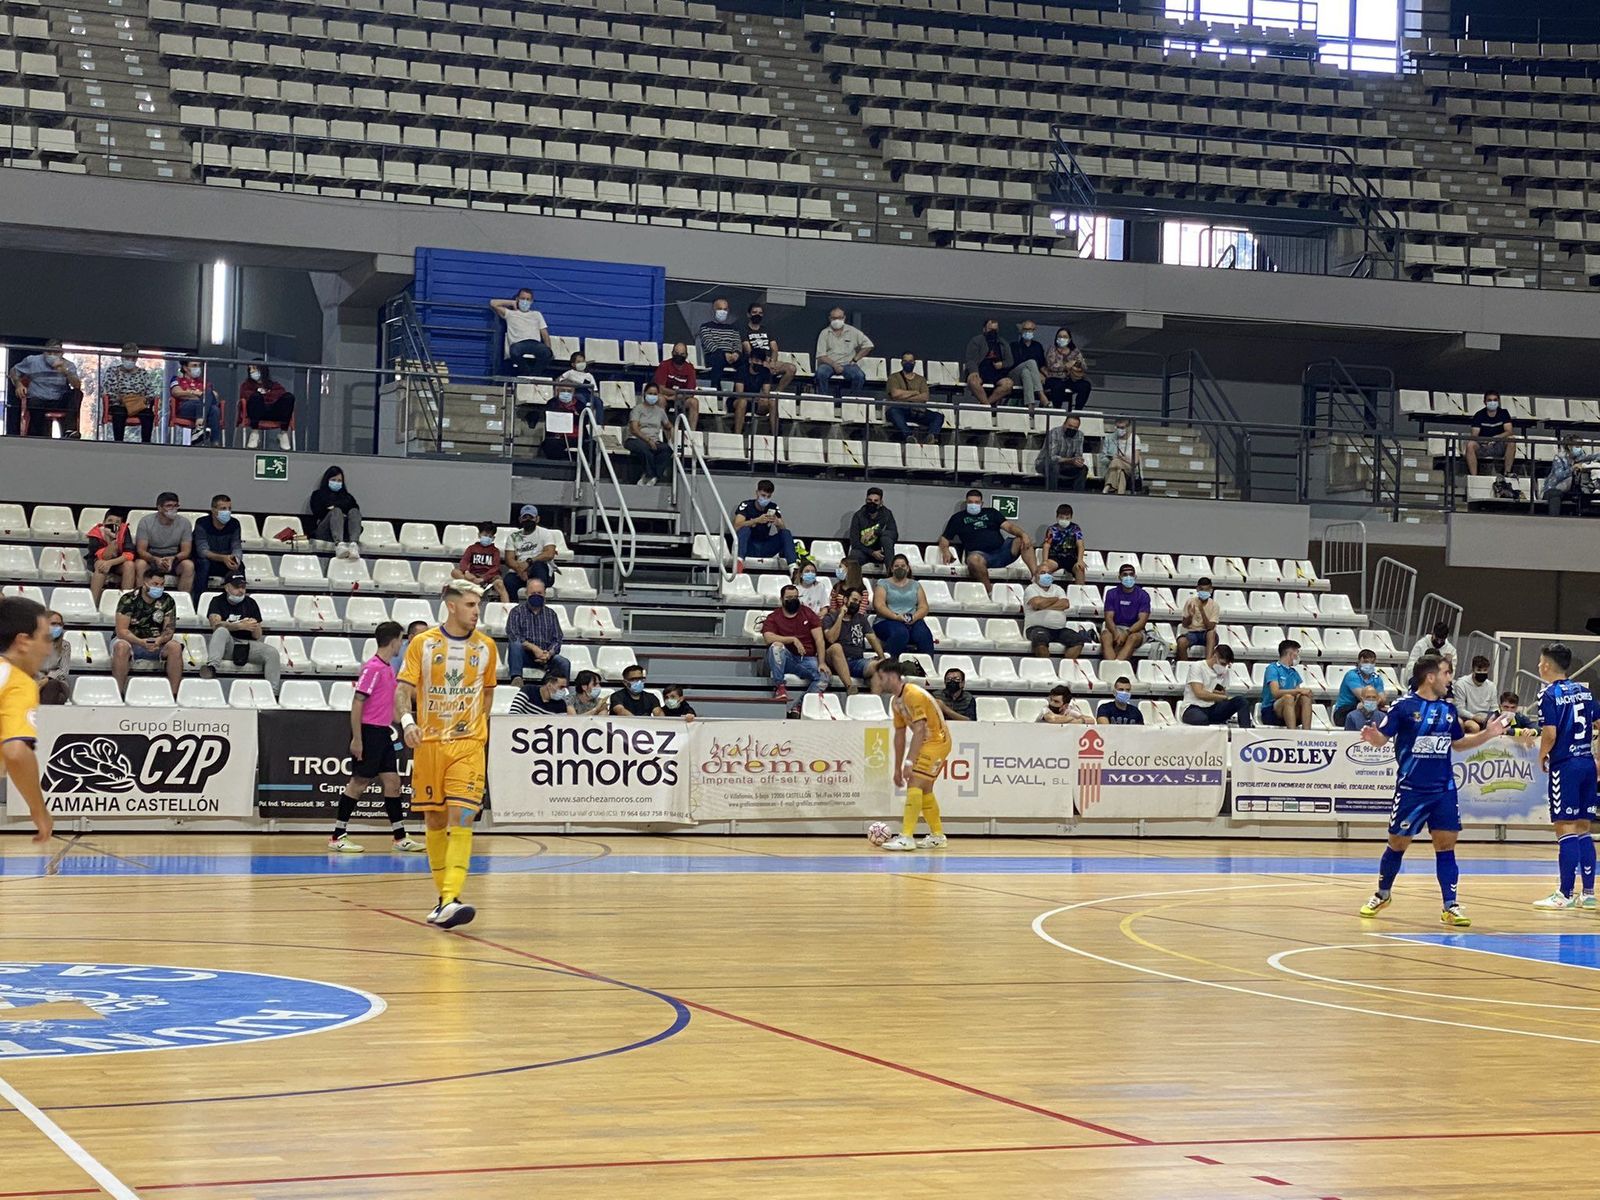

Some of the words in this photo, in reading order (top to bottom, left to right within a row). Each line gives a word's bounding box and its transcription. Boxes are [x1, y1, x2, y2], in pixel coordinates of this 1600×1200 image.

[119, 719, 168, 734] Grupo
[172, 719, 230, 735] Blumaq
[1573, 703, 1588, 740] 5
[511, 722, 679, 755] sánchez
[710, 735, 792, 761] gráficas
[1239, 747, 1338, 765] CODELEY
[139, 739, 222, 785] C2P
[982, 756, 1070, 769] TECMACO
[1108, 751, 1150, 767] decor
[1153, 752, 1224, 770] escayolas
[531, 756, 679, 787] amorós
[702, 776, 753, 785] Imprenta
[760, 775, 797, 784] off-set
[804, 776, 810, 785] y
[817, 774, 852, 785] digital
[982, 774, 1003, 785] LA
[1006, 774, 1046, 786] VALL,
[1108, 773, 1179, 784] MOYA,
[1184, 774, 1219, 783] S.L.
[425, 786, 433, 800] 9
[549, 795, 653, 803] www.sanchezamoros.com
[44, 797, 120, 812] YAMAHA
[125, 795, 219, 812] CASTELLÓN
